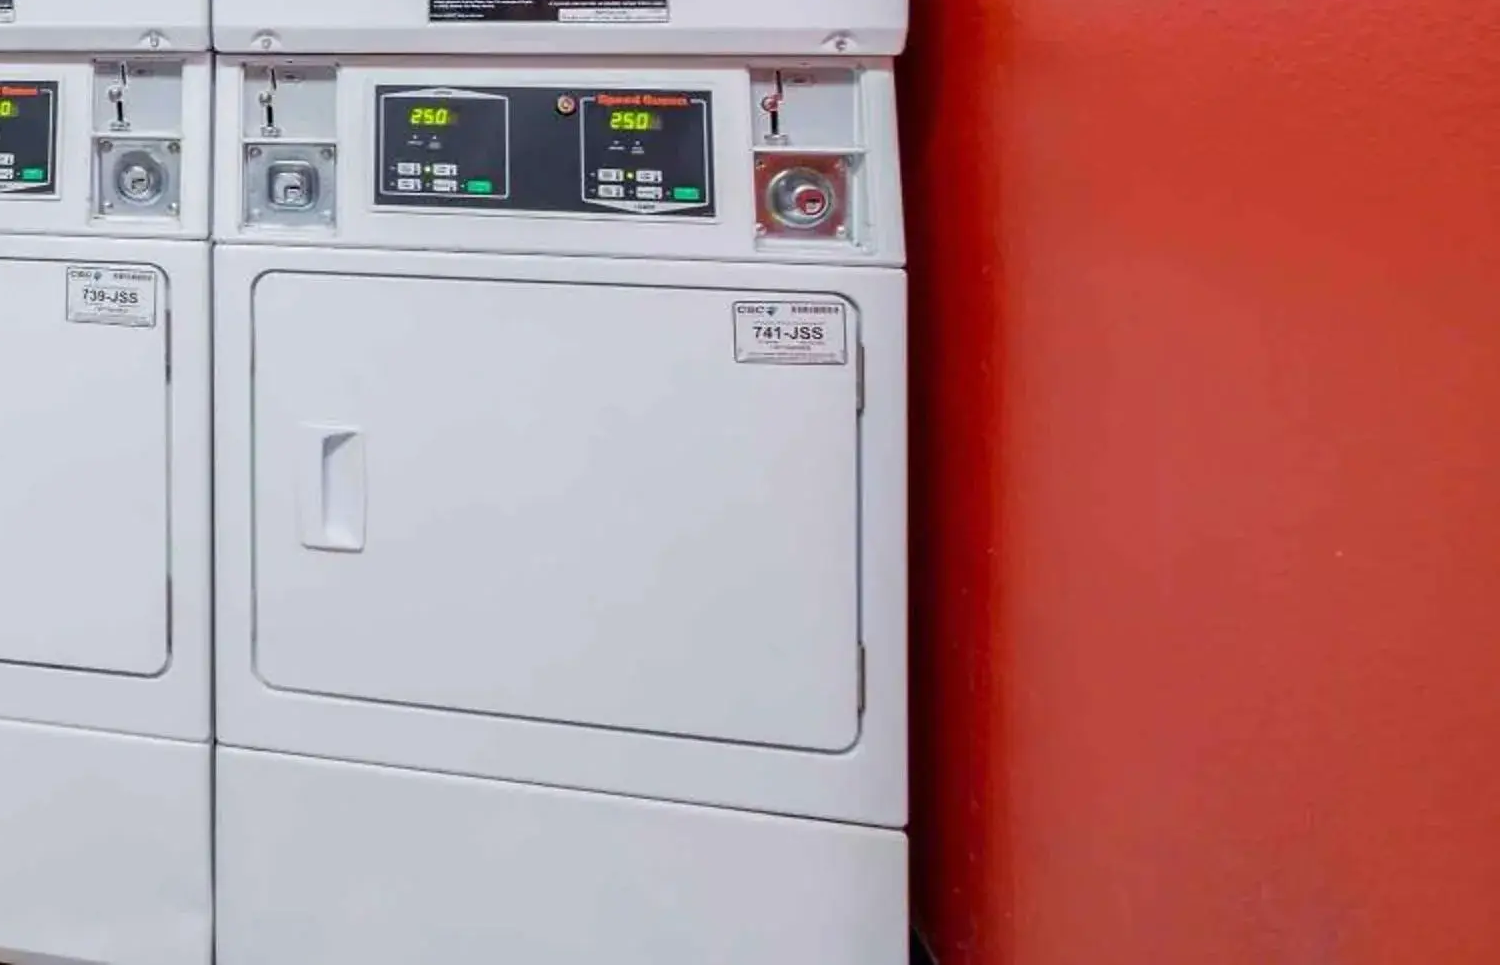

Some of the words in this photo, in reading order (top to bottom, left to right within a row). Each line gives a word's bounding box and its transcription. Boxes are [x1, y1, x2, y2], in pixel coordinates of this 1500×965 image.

[411, 108, 447, 124] 250
[611, 112, 649, 129] 250
[83, 288, 138, 304] 739-JSS
[752, 326, 824, 340] 741-JSS
